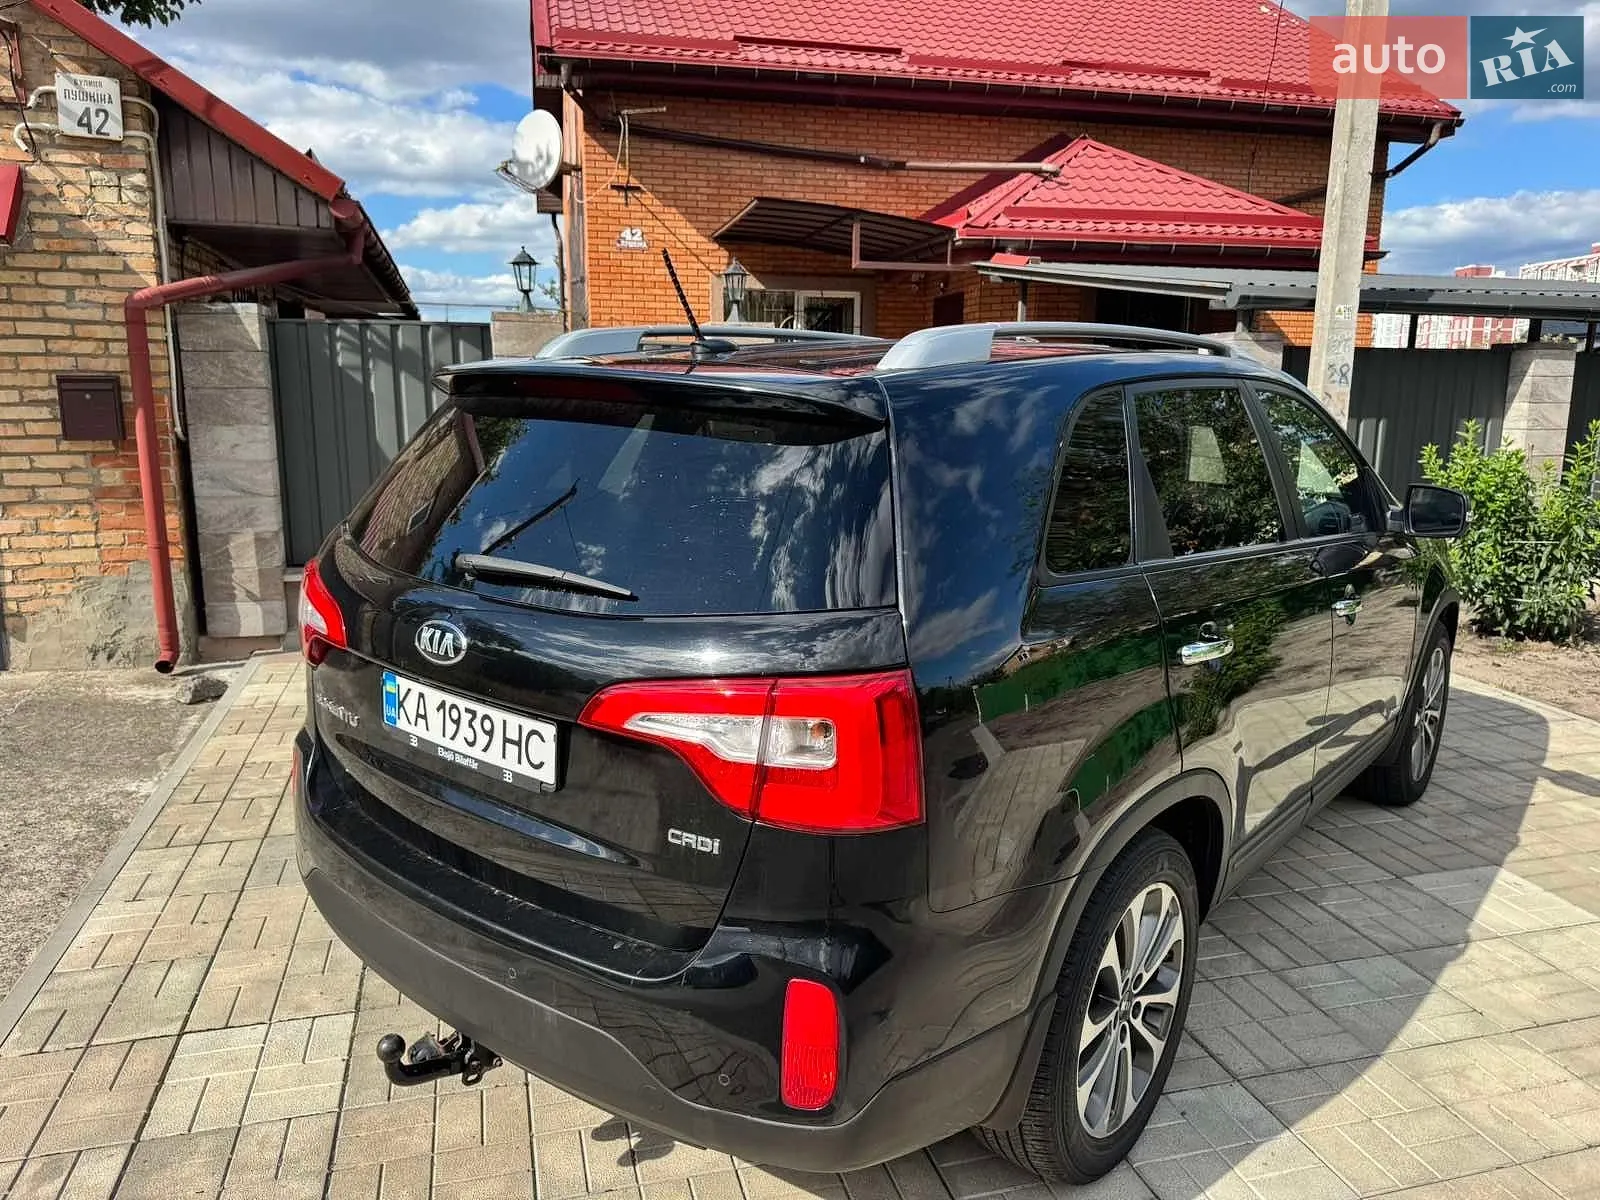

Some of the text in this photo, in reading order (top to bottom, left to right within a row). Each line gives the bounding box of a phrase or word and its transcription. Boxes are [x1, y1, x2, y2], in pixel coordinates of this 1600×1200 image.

[63, 88, 114, 105] ПУШКІНА
[77, 106, 110, 137] 42
[620, 227, 643, 241] 42
[420, 626, 455, 658] KIA
[385, 704, 396, 718] UA
[397, 683, 430, 732] KA
[436, 699, 495, 753] 1939
[502, 719, 546, 770] HC
